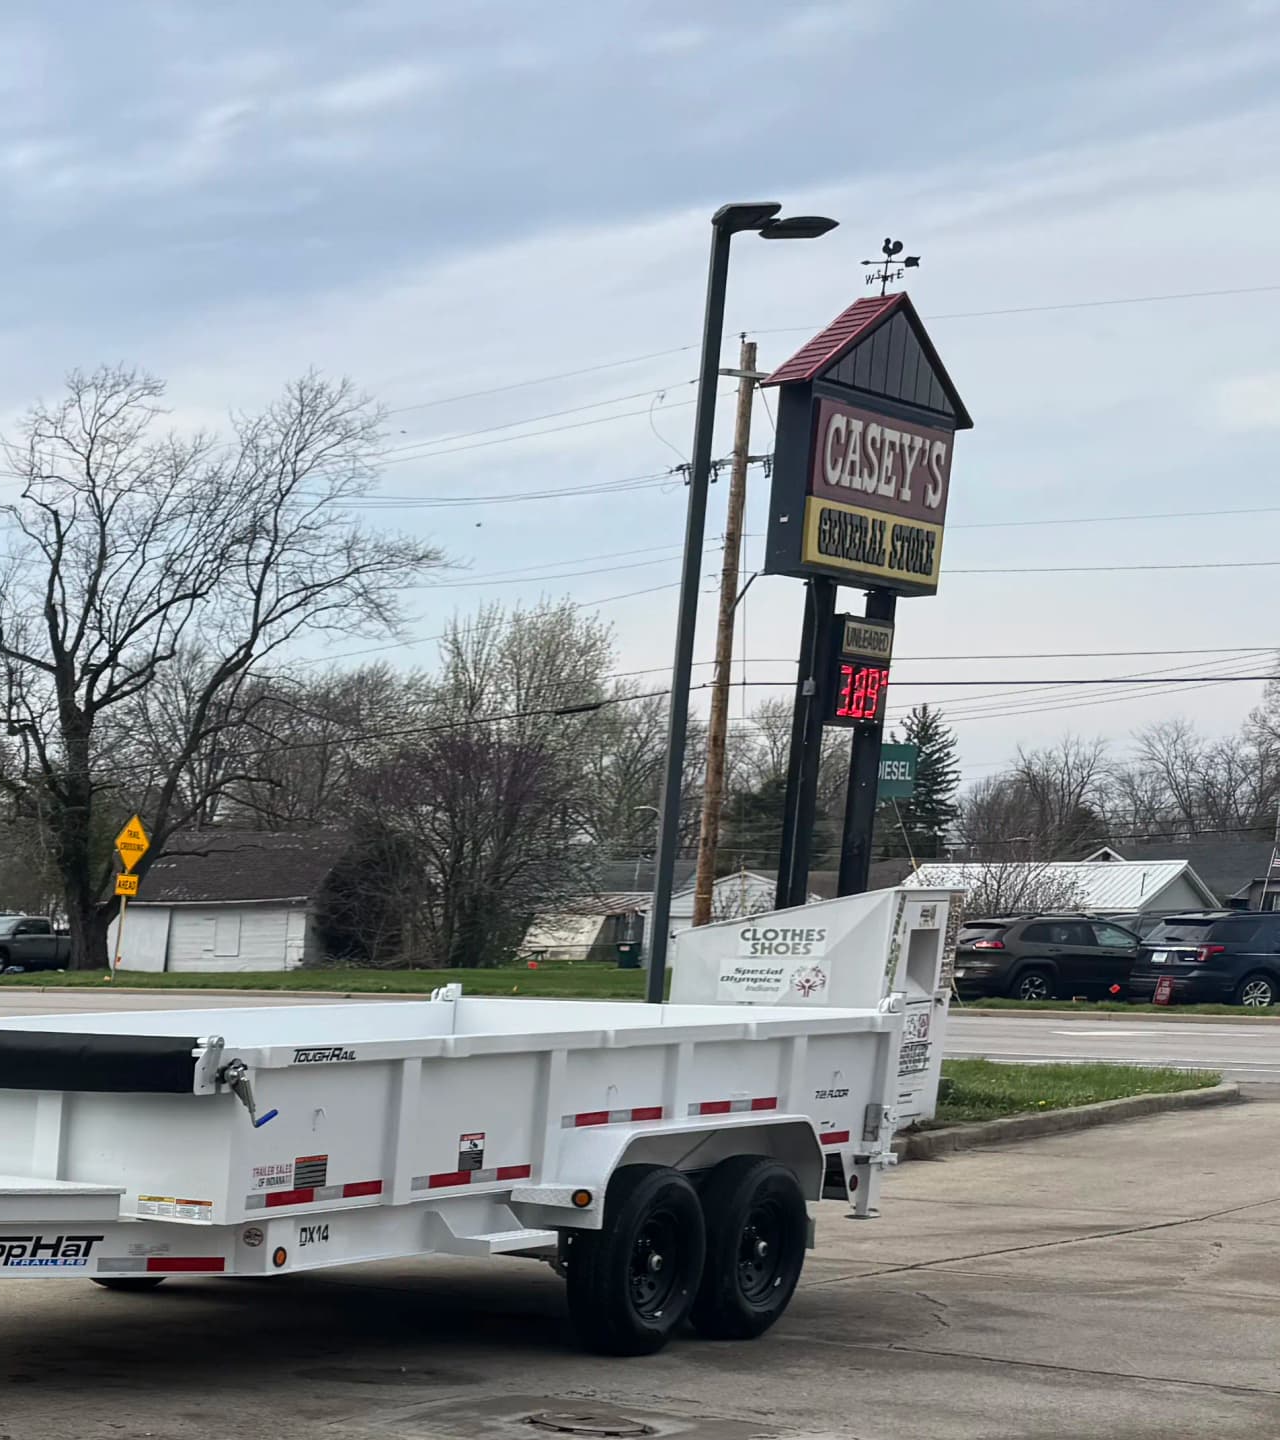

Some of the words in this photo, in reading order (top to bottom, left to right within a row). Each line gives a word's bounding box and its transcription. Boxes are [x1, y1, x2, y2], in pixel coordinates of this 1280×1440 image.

[825, 413, 946, 509] CASEY'S
[818, 507, 886, 567] GENERAL
[888, 523, 936, 576] STORE
[846, 626, 889, 652] UNLEADED
[118, 880, 137, 890] AHEAD
[740, 928, 827, 942] CLOTHES
[750, 942, 813, 955] SHOES
[734, 967, 784, 976] Special
[720, 975, 782, 984] Olympics
[299, 1224, 329, 1246] DX14
[9, 1258, 88, 1266] TRAILERS
